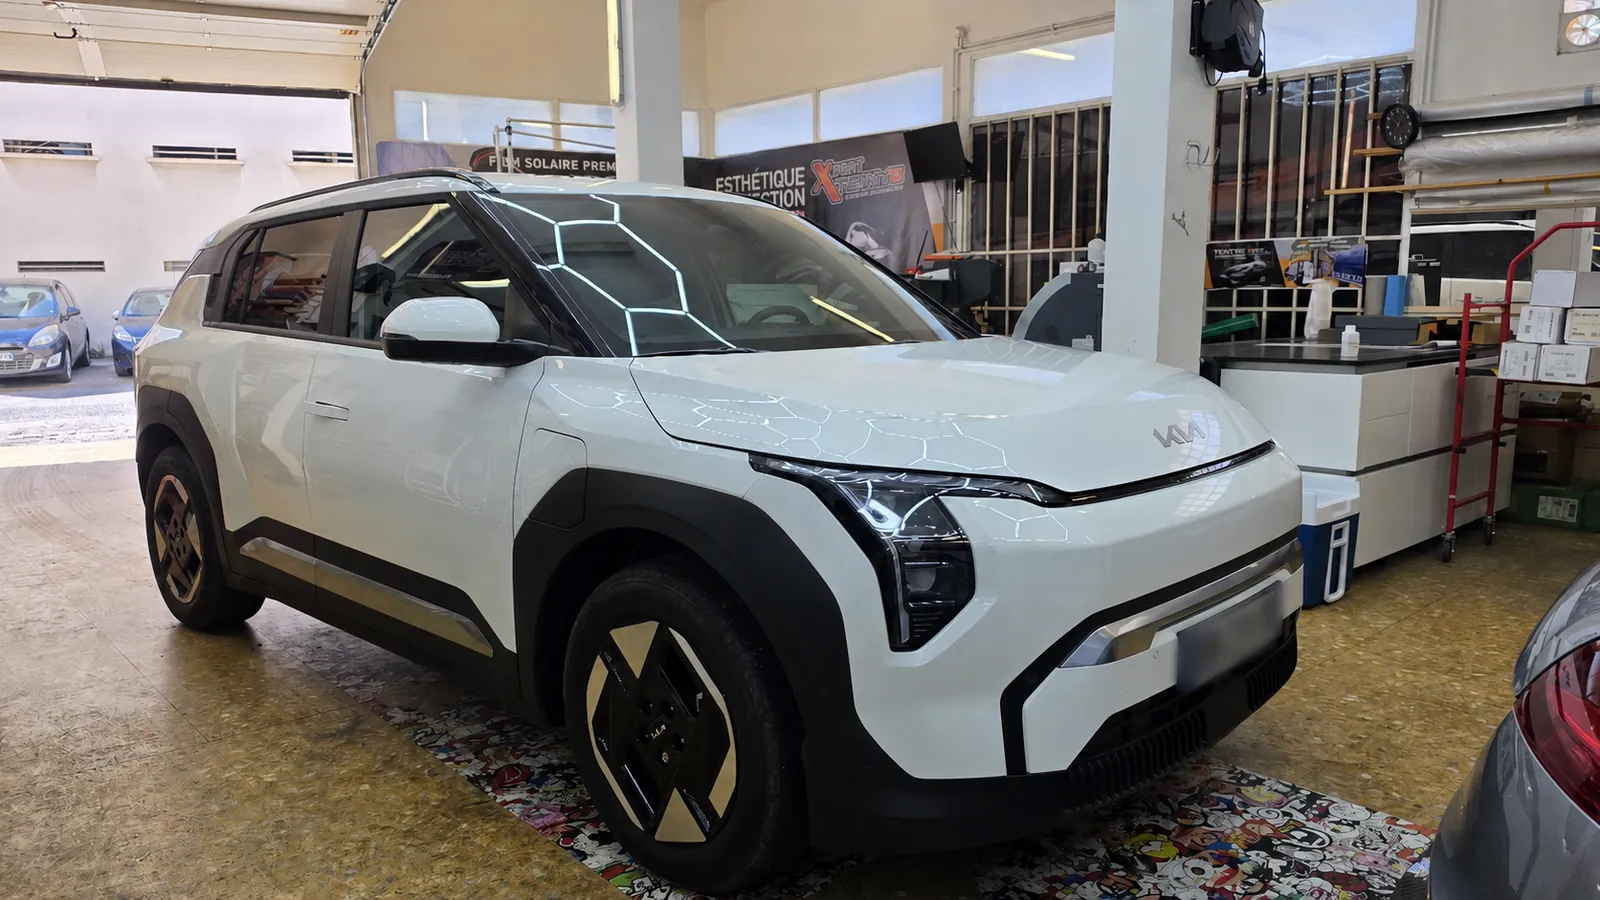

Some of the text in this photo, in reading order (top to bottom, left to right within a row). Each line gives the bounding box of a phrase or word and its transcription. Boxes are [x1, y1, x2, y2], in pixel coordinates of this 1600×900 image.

[489, 155, 521, 168] FLM
[525, 157, 579, 171] SOLAIRE
[715, 166, 806, 193] ESTHÉTIQUE
[1153, 421, 1206, 448] KIA
